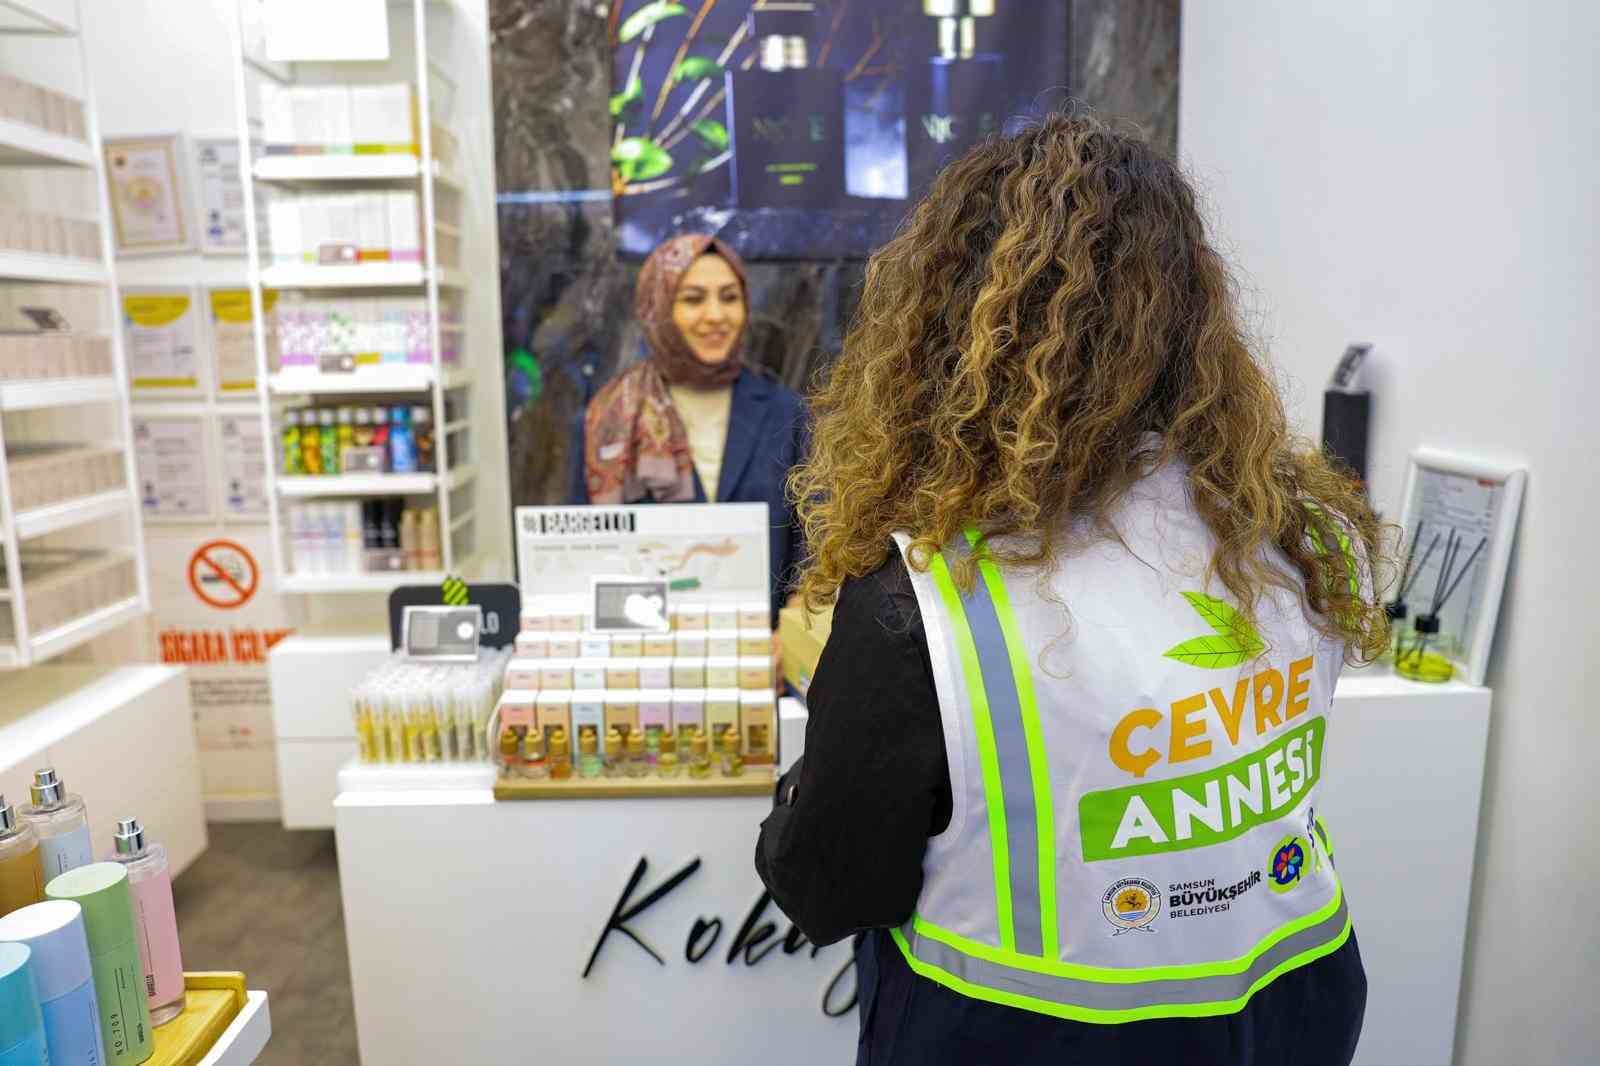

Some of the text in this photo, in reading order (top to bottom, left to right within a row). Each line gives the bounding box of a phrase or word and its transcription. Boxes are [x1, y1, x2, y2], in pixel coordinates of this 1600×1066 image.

[1109, 655, 1314, 777] ÇEVRE
[1110, 729, 1314, 849] ANNESİ
[1169, 879, 1215, 892] SAMSUN
[1169, 870, 1262, 908] BÜYÜKŞEHİR
[1170, 903, 1230, 919] BELEDİYESİ
